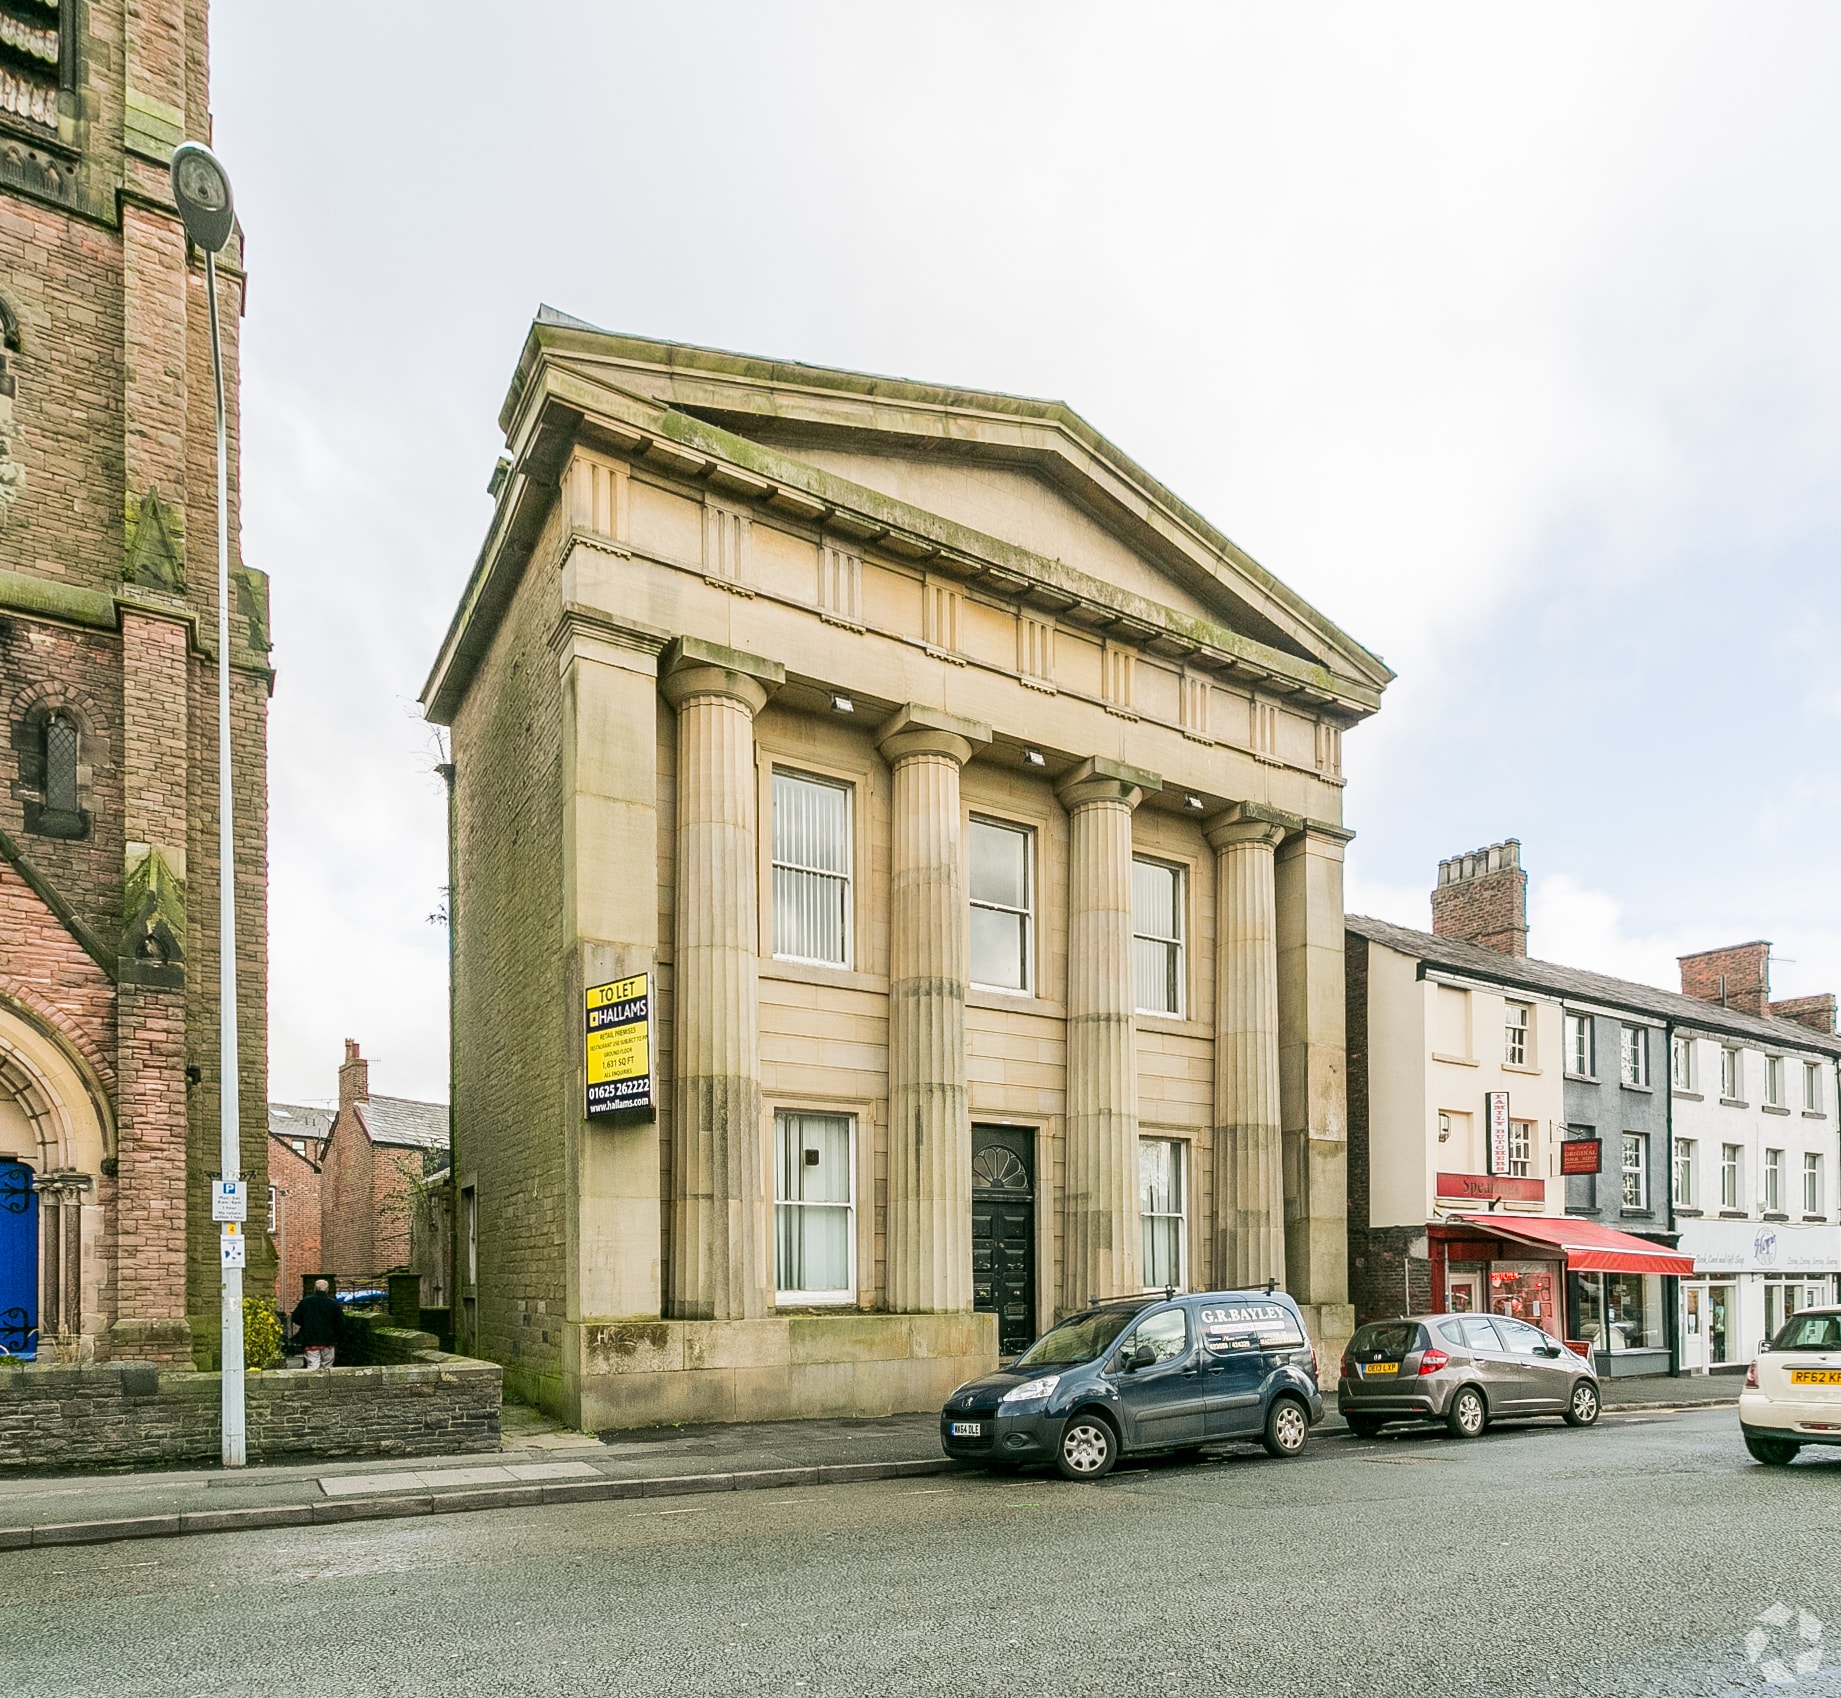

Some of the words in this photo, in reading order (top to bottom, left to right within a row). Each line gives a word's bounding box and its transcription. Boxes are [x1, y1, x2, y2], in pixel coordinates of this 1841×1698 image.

[599, 988, 613, 1003] TO
[616, 981, 636, 999] LET
[599, 1000, 646, 1024] HALLAMS
[600, 1032, 614, 1040] RETAIL
[615, 1027, 636, 1037] PREMISES
[604, 1049, 619, 1057] GROUND
[602, 1060, 616, 1070] 1,631
[618, 1058, 626, 1066] SQ
[627, 1056, 634, 1064] FT
[612, 1068, 632, 1076] ENQUIRIES
[589, 1084, 615, 1100] 01625
[616, 1079, 650, 1095] 262222
[590, 1098, 648, 1113] www.hallams.com
[1494, 1094, 1506, 1126] FAMILY
[1494, 1130, 1506, 1171] BUTCHERS
[1796, 1372, 1826, 1382] RF62
[968, 1425, 979, 1435] DLE
